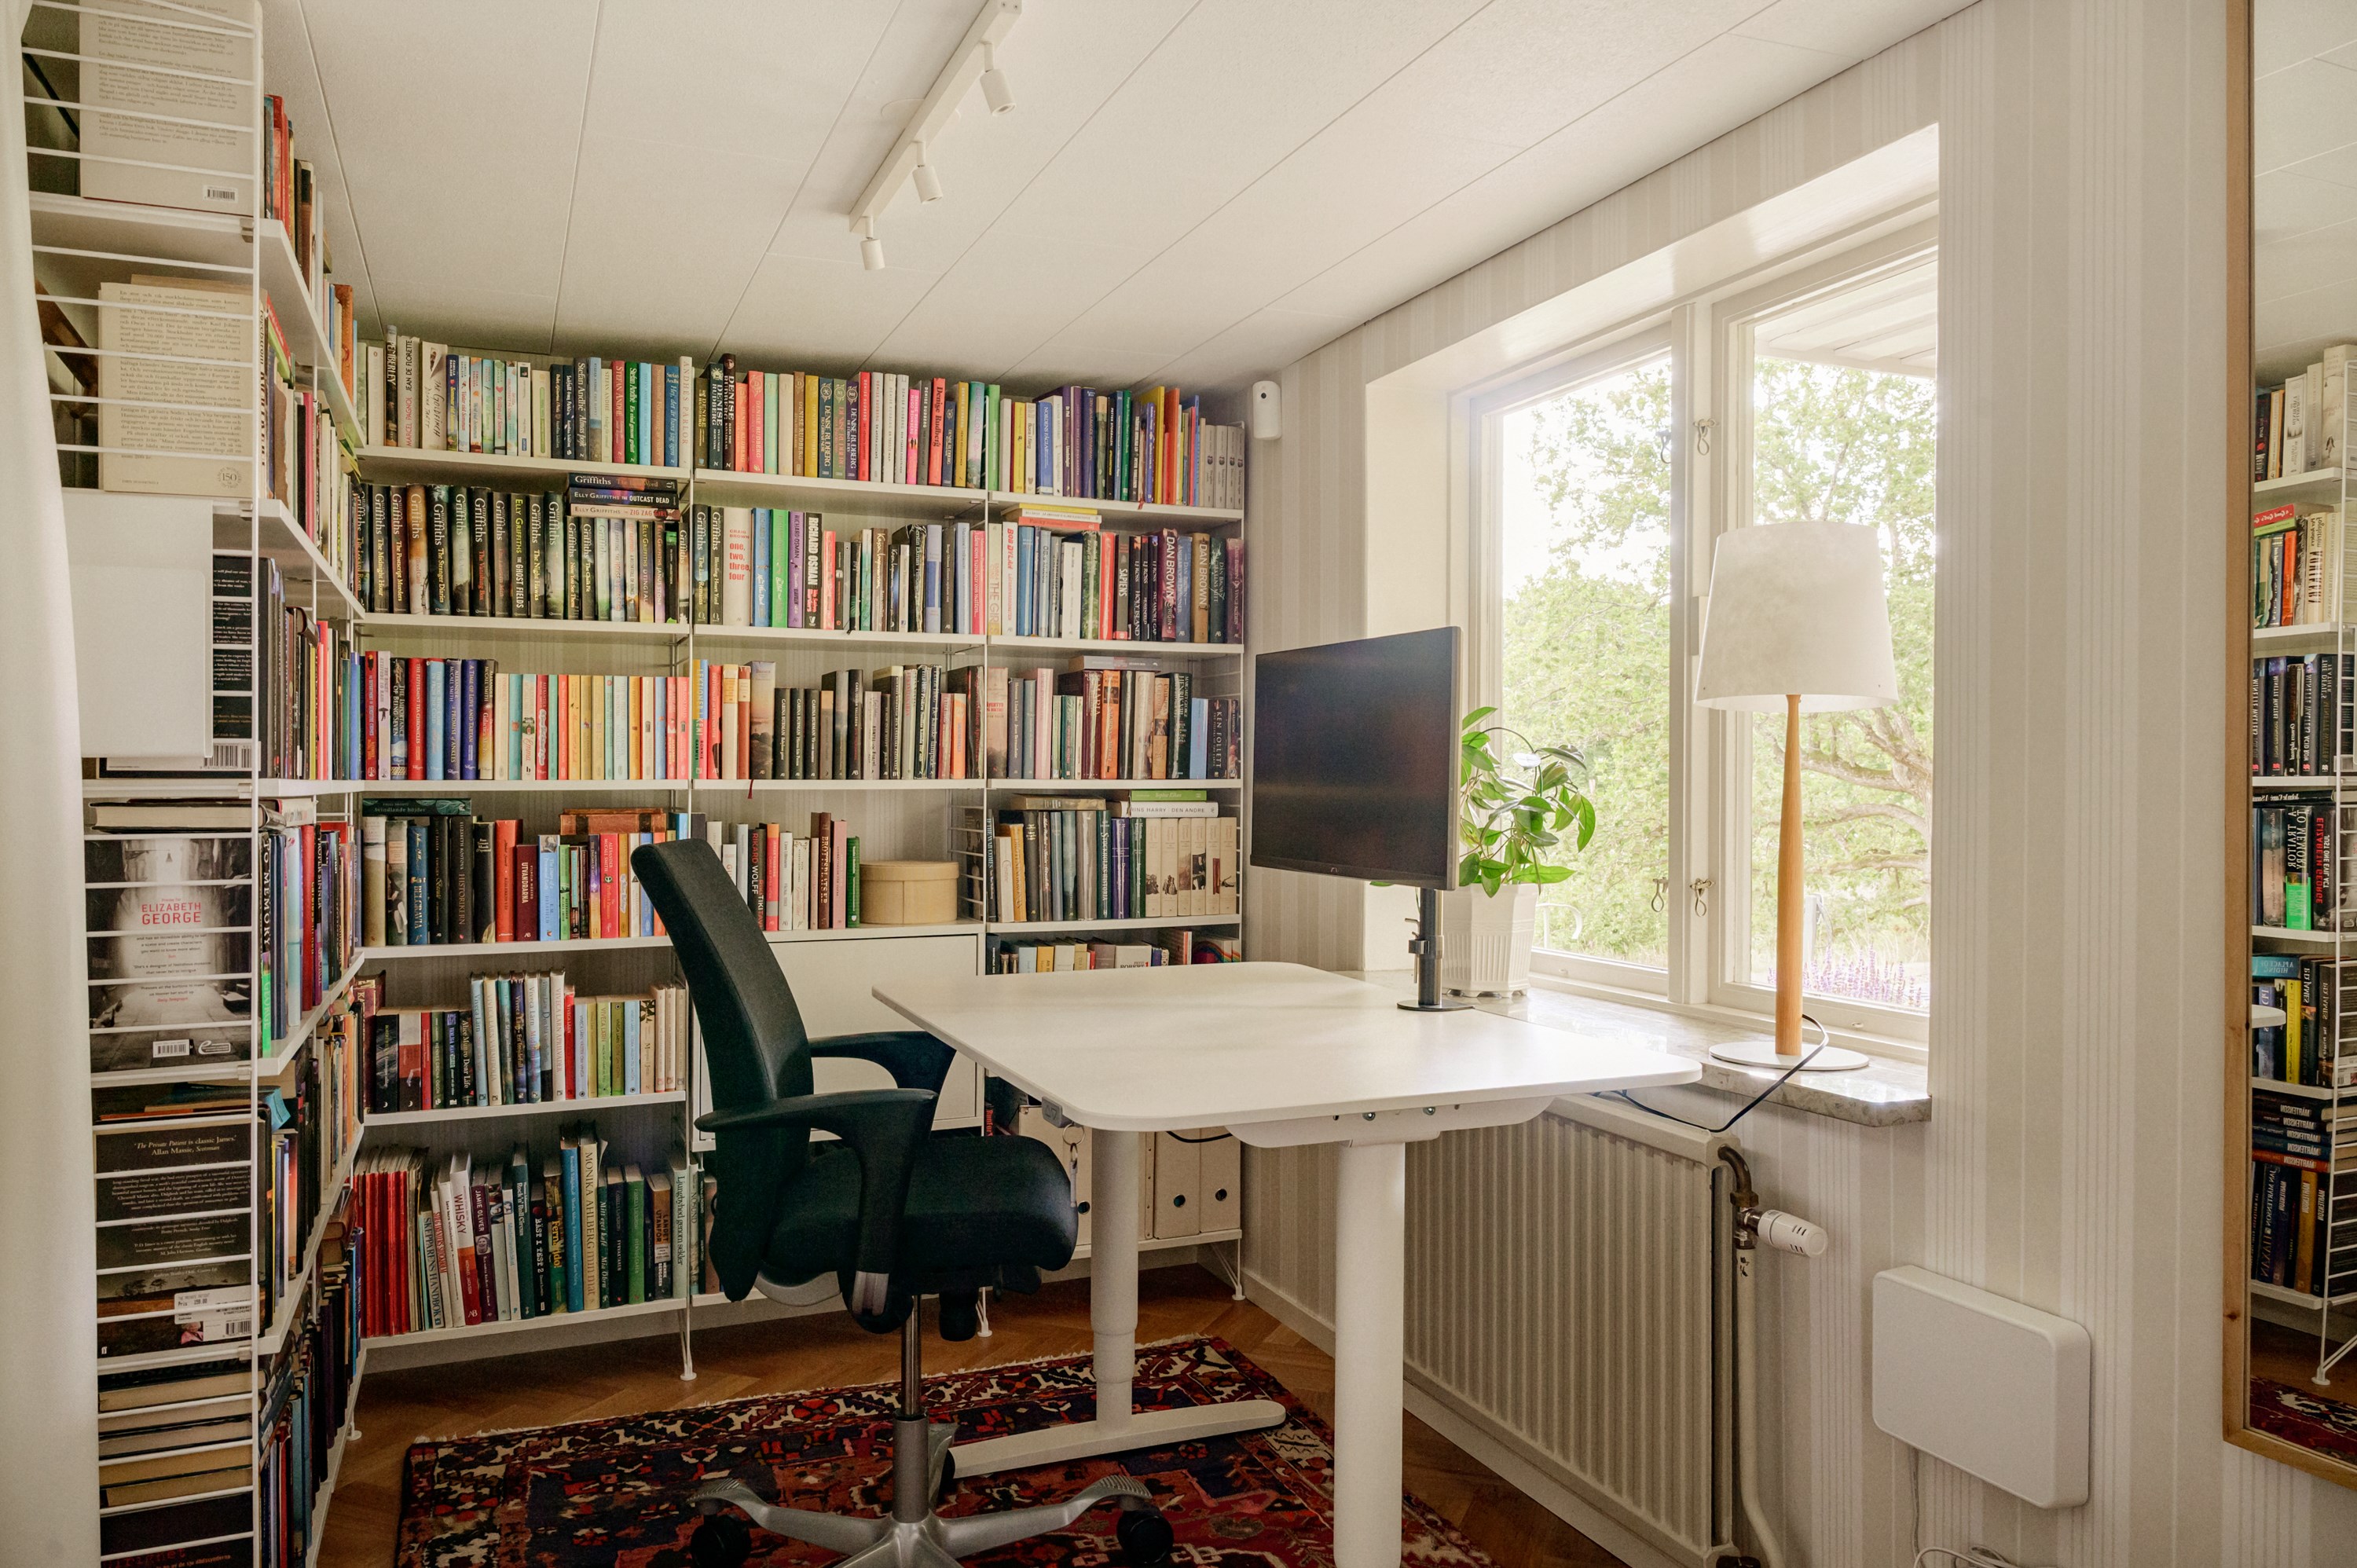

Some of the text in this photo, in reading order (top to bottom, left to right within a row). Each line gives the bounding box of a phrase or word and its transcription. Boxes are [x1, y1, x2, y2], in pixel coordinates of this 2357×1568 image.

[405, 340, 413, 365] FLORETTE
[405, 366, 412, 376] DE
[433, 394, 445, 438] GOLDFINCH
[933, 415, 941, 448] Rudberg
[221, 471, 239, 483] 150
[574, 474, 612, 485] Griffiths
[574, 490, 669, 504] ELLY GRIFFITHS OUTCAST DEAD
[375, 493, 386, 535] Griffiths
[392, 493, 404, 535] Griffiths
[410, 493, 424, 540] Griffiths
[433, 503, 445, 547] Griffiths
[455, 493, 467, 536] Griffiths
[474, 497, 486, 543] Griffiths
[494, 500, 506, 541] Griffiths
[530, 503, 543, 544] Griffiths
[548, 500, 562, 546] Griffiths
[696, 511, 706, 551] Griffiths
[712, 511, 721, 551] Griffiths
[515, 499, 524, 609] ELLY GRIFFITHS GHOST FIELDS
[568, 522, 578, 558] Griffiths
[583, 523, 592, 559] Griffiths
[679, 529, 688, 564] Griffiths
[729, 542, 746, 552] one,
[729, 552, 746, 562] two,
[808, 517, 819, 586] RICHARD OSMAN
[728, 572, 746, 581] four
[1119, 568, 1128, 598] SAPIENS
[1166, 536, 1175, 600] DAN BROWN
[1199, 544, 1208, 606] DAN BROWN
[990, 581, 999, 601] THE
[393, 685, 399, 694] OF
[695, 716, 705, 736] KEMI
[522, 738, 535, 762] Emma
[1101, 832, 1109, 901] STOCKHOLMSHISTORIA
[141, 902, 201, 913] ELIZABETH
[141, 911, 202, 925] GEORGE
[453, 1193, 467, 1235] WHISKY
[585, 1152, 596, 1249] MONIKA AHLBERG
[535, 1218, 544, 1237] BÄST
[674, 1219, 686, 1266] genom sekler
[423, 1218, 442, 1317] SKEPPARENS HANDBOK
